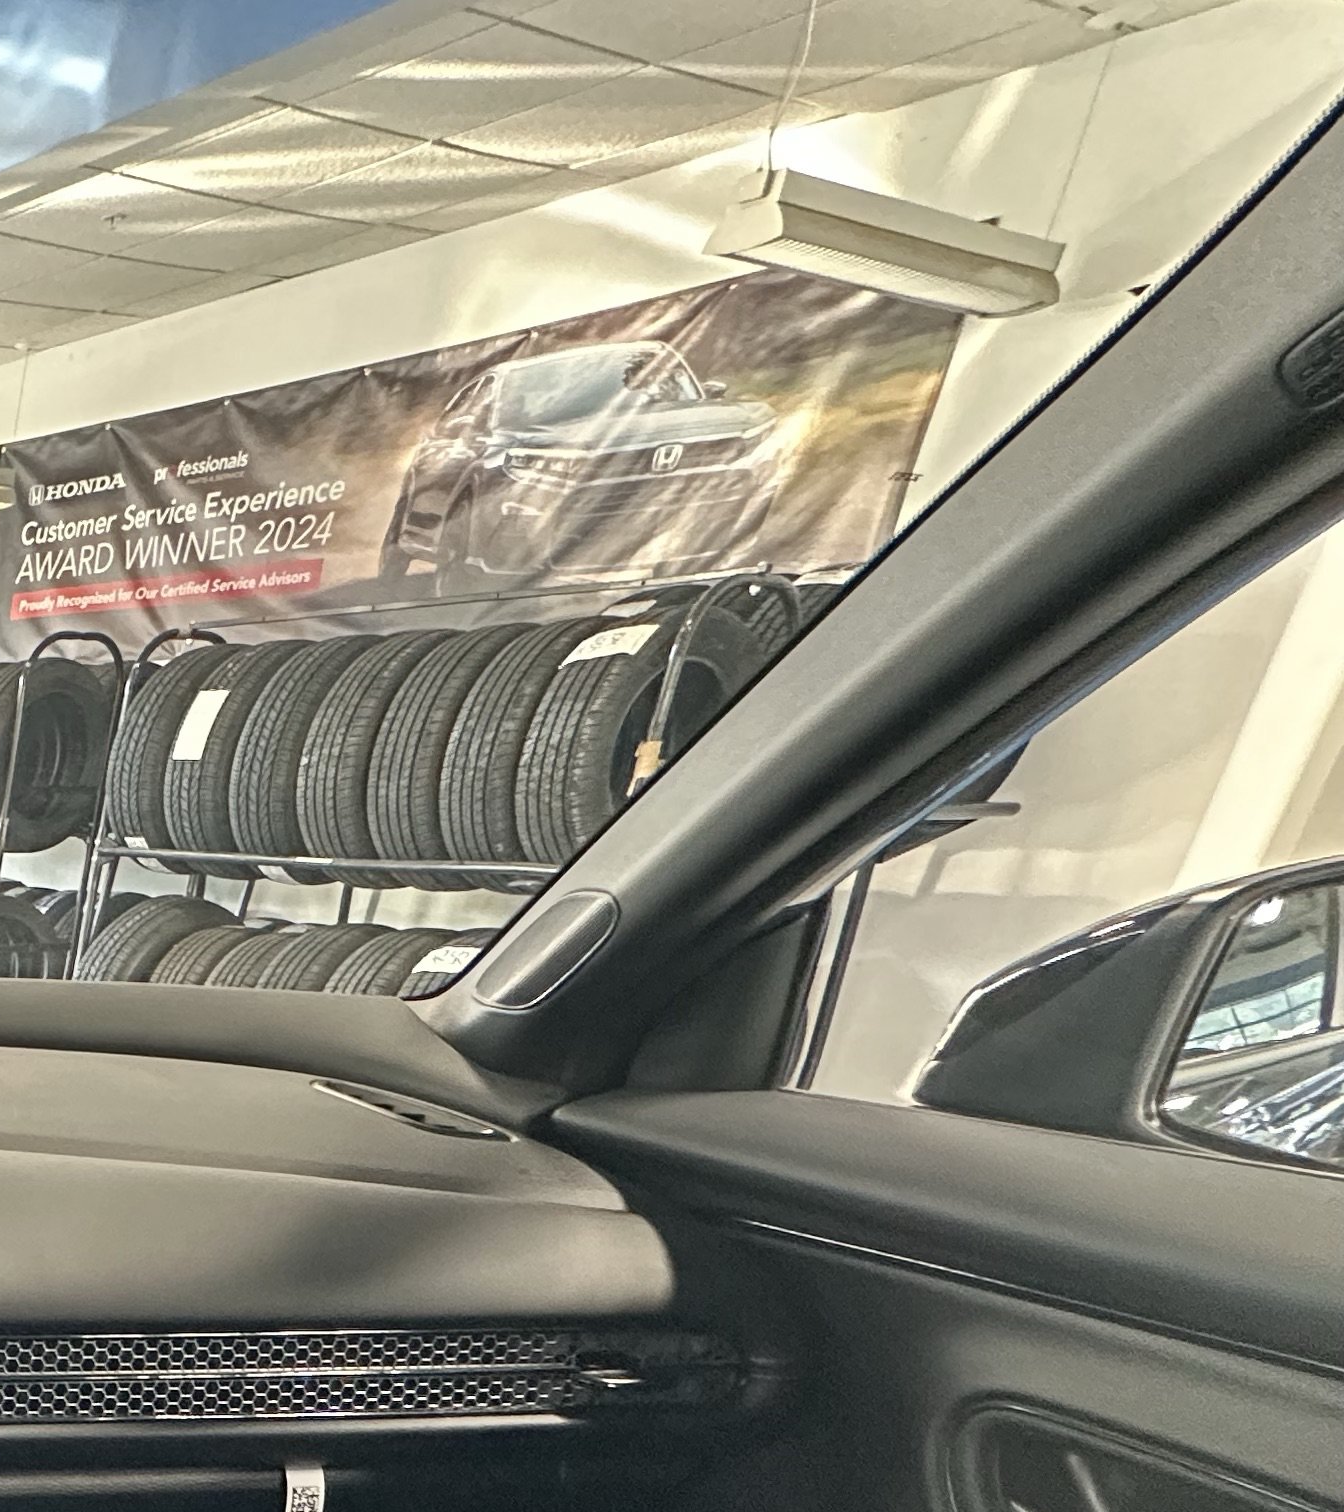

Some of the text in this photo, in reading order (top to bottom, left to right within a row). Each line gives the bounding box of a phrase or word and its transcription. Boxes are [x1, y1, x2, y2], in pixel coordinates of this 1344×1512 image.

[21, 479, 346, 546] Customer Service Experience
[45, 472, 126, 501] HONDA
[15, 511, 336, 585] AWARD WINNER 2024
[18, 570, 311, 613] Proudly Recognized for Our Certified Service Advisors
